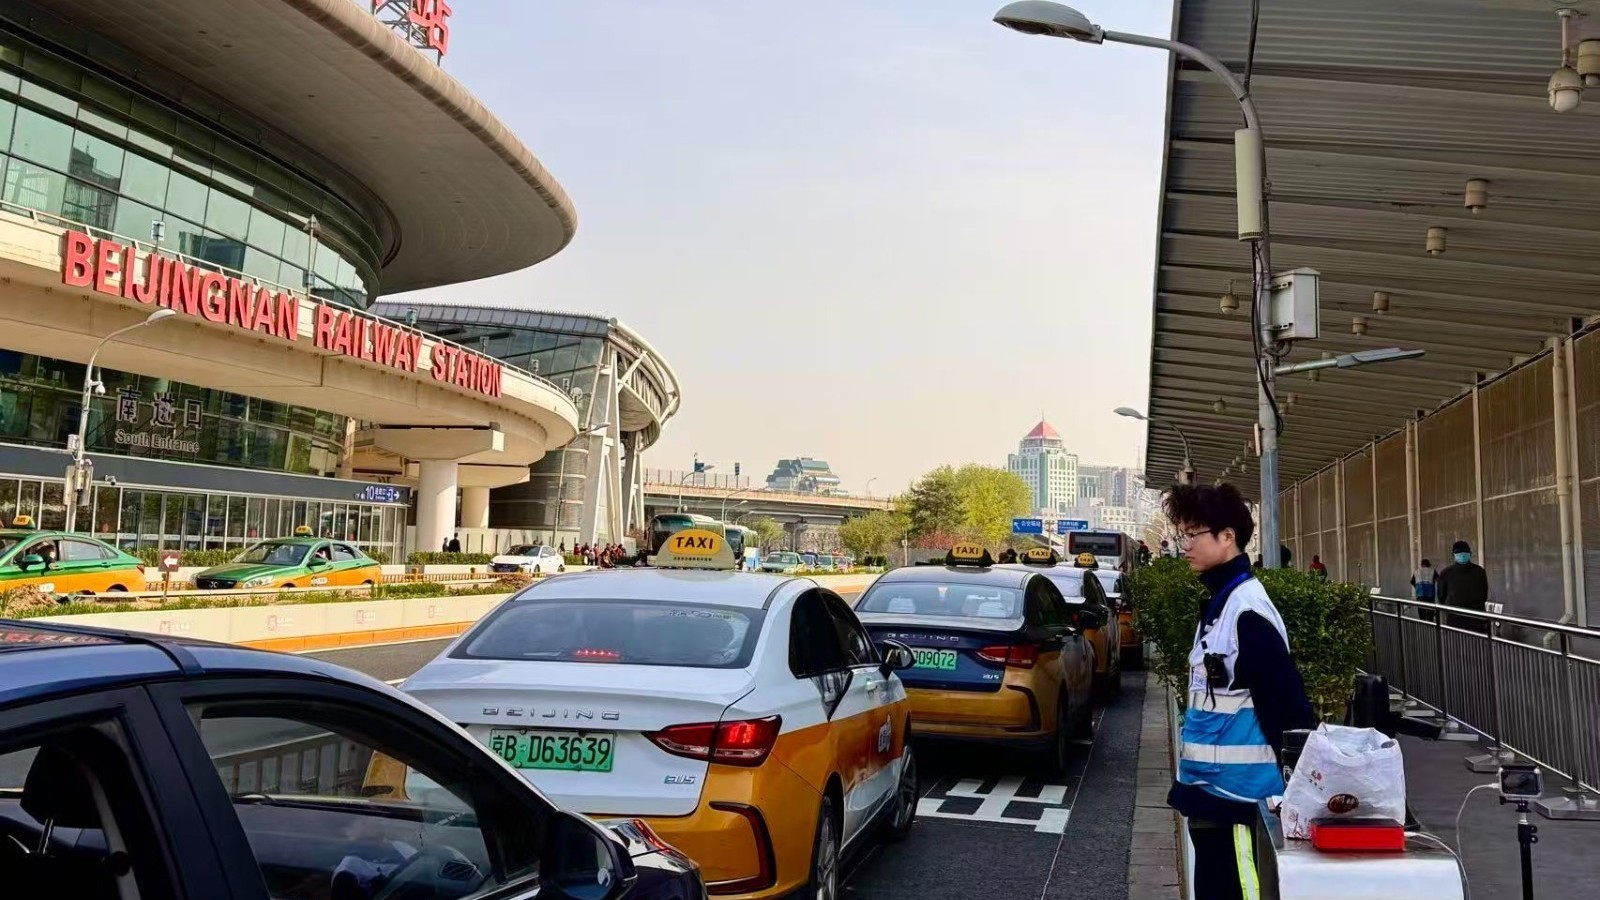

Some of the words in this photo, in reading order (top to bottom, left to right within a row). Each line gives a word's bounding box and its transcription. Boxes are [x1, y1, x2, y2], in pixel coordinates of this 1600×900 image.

[62, 230, 300, 342] BEIJINGNAN
[314, 304, 424, 373] RAILWAY
[432, 342, 503, 399] STATION
[115, 428, 150, 448] South
[151, 433, 200, 454] Entrance
[676, 536, 714, 549] TAXI
[955, 545, 979, 556] TAXI
[1031, 549, 1049, 557] TAXI
[887, 632, 960, 641] BEIJING
[482, 707, 620, 721] BEIJING
